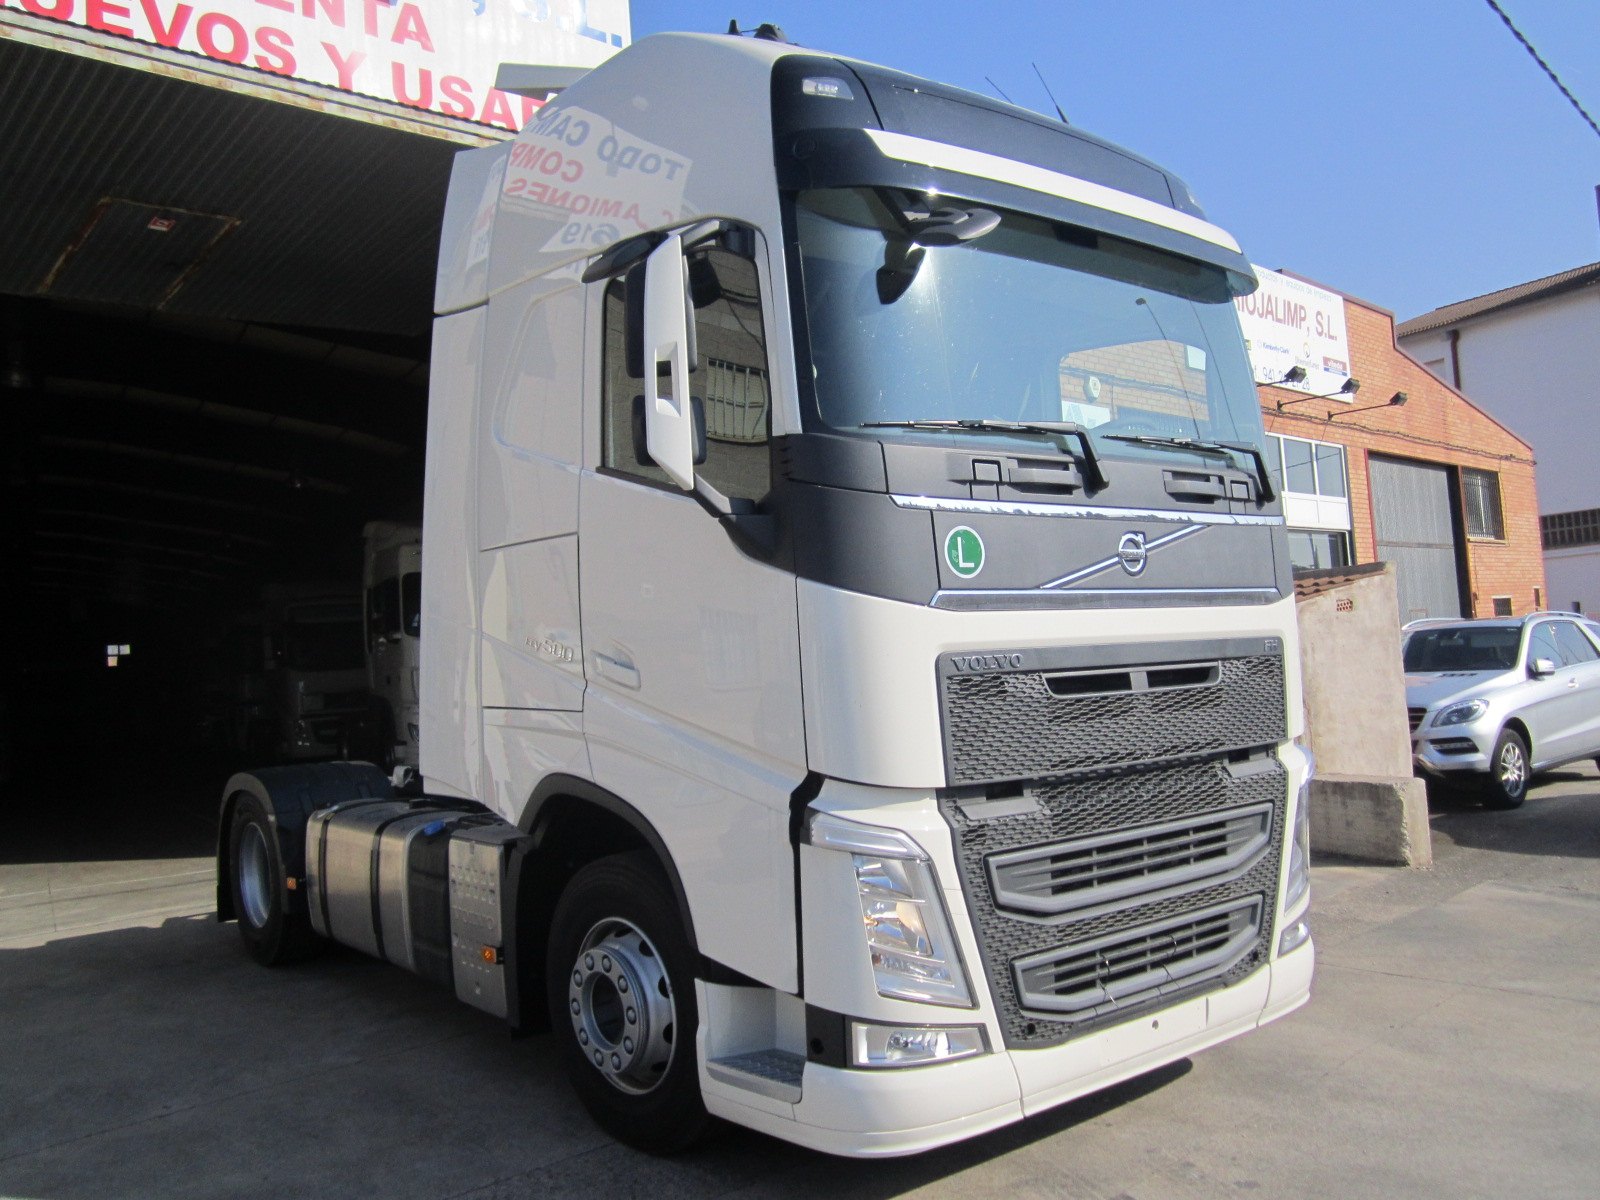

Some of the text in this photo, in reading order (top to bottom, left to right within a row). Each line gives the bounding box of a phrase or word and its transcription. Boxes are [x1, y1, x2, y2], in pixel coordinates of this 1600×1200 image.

[0, 0, 297, 76] UEVOS
[320, 41, 367, 91] Y
[1315, 310, 1338, 341] S.L.
[957, 536, 975, 568] L
[950, 653, 1024, 673] VOLVO
